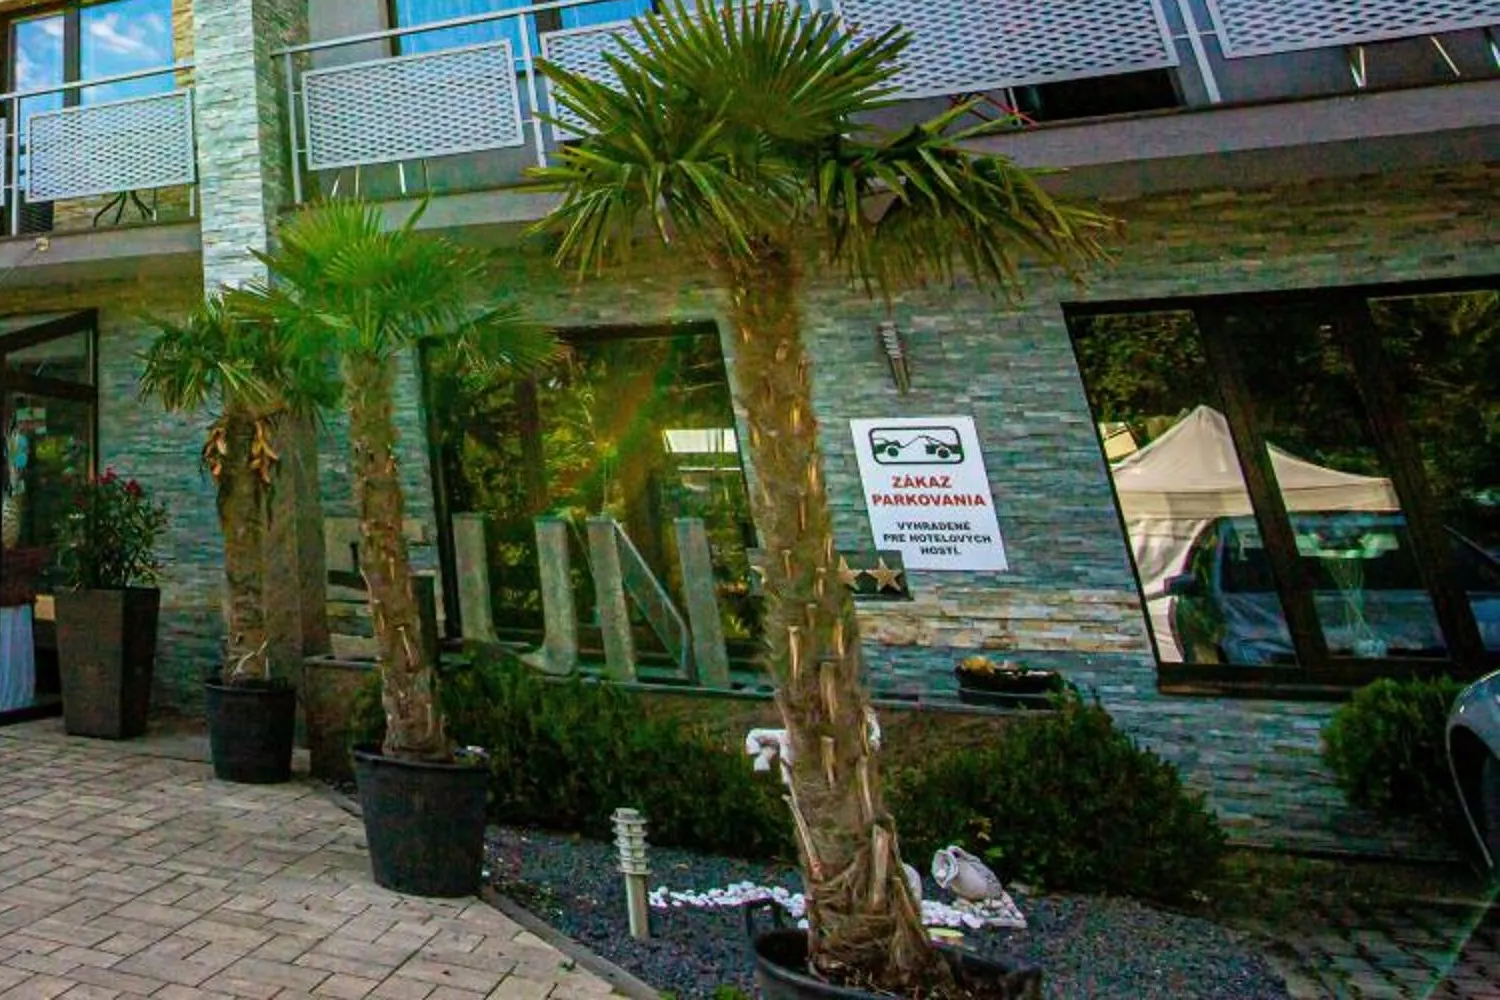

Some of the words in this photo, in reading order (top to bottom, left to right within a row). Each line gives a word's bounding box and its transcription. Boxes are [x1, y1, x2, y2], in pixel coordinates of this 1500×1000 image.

[891, 474, 953, 489] ZÁKAZ
[871, 493, 987, 507] PARKOVANIA
[883, 533, 906, 543] PRE
